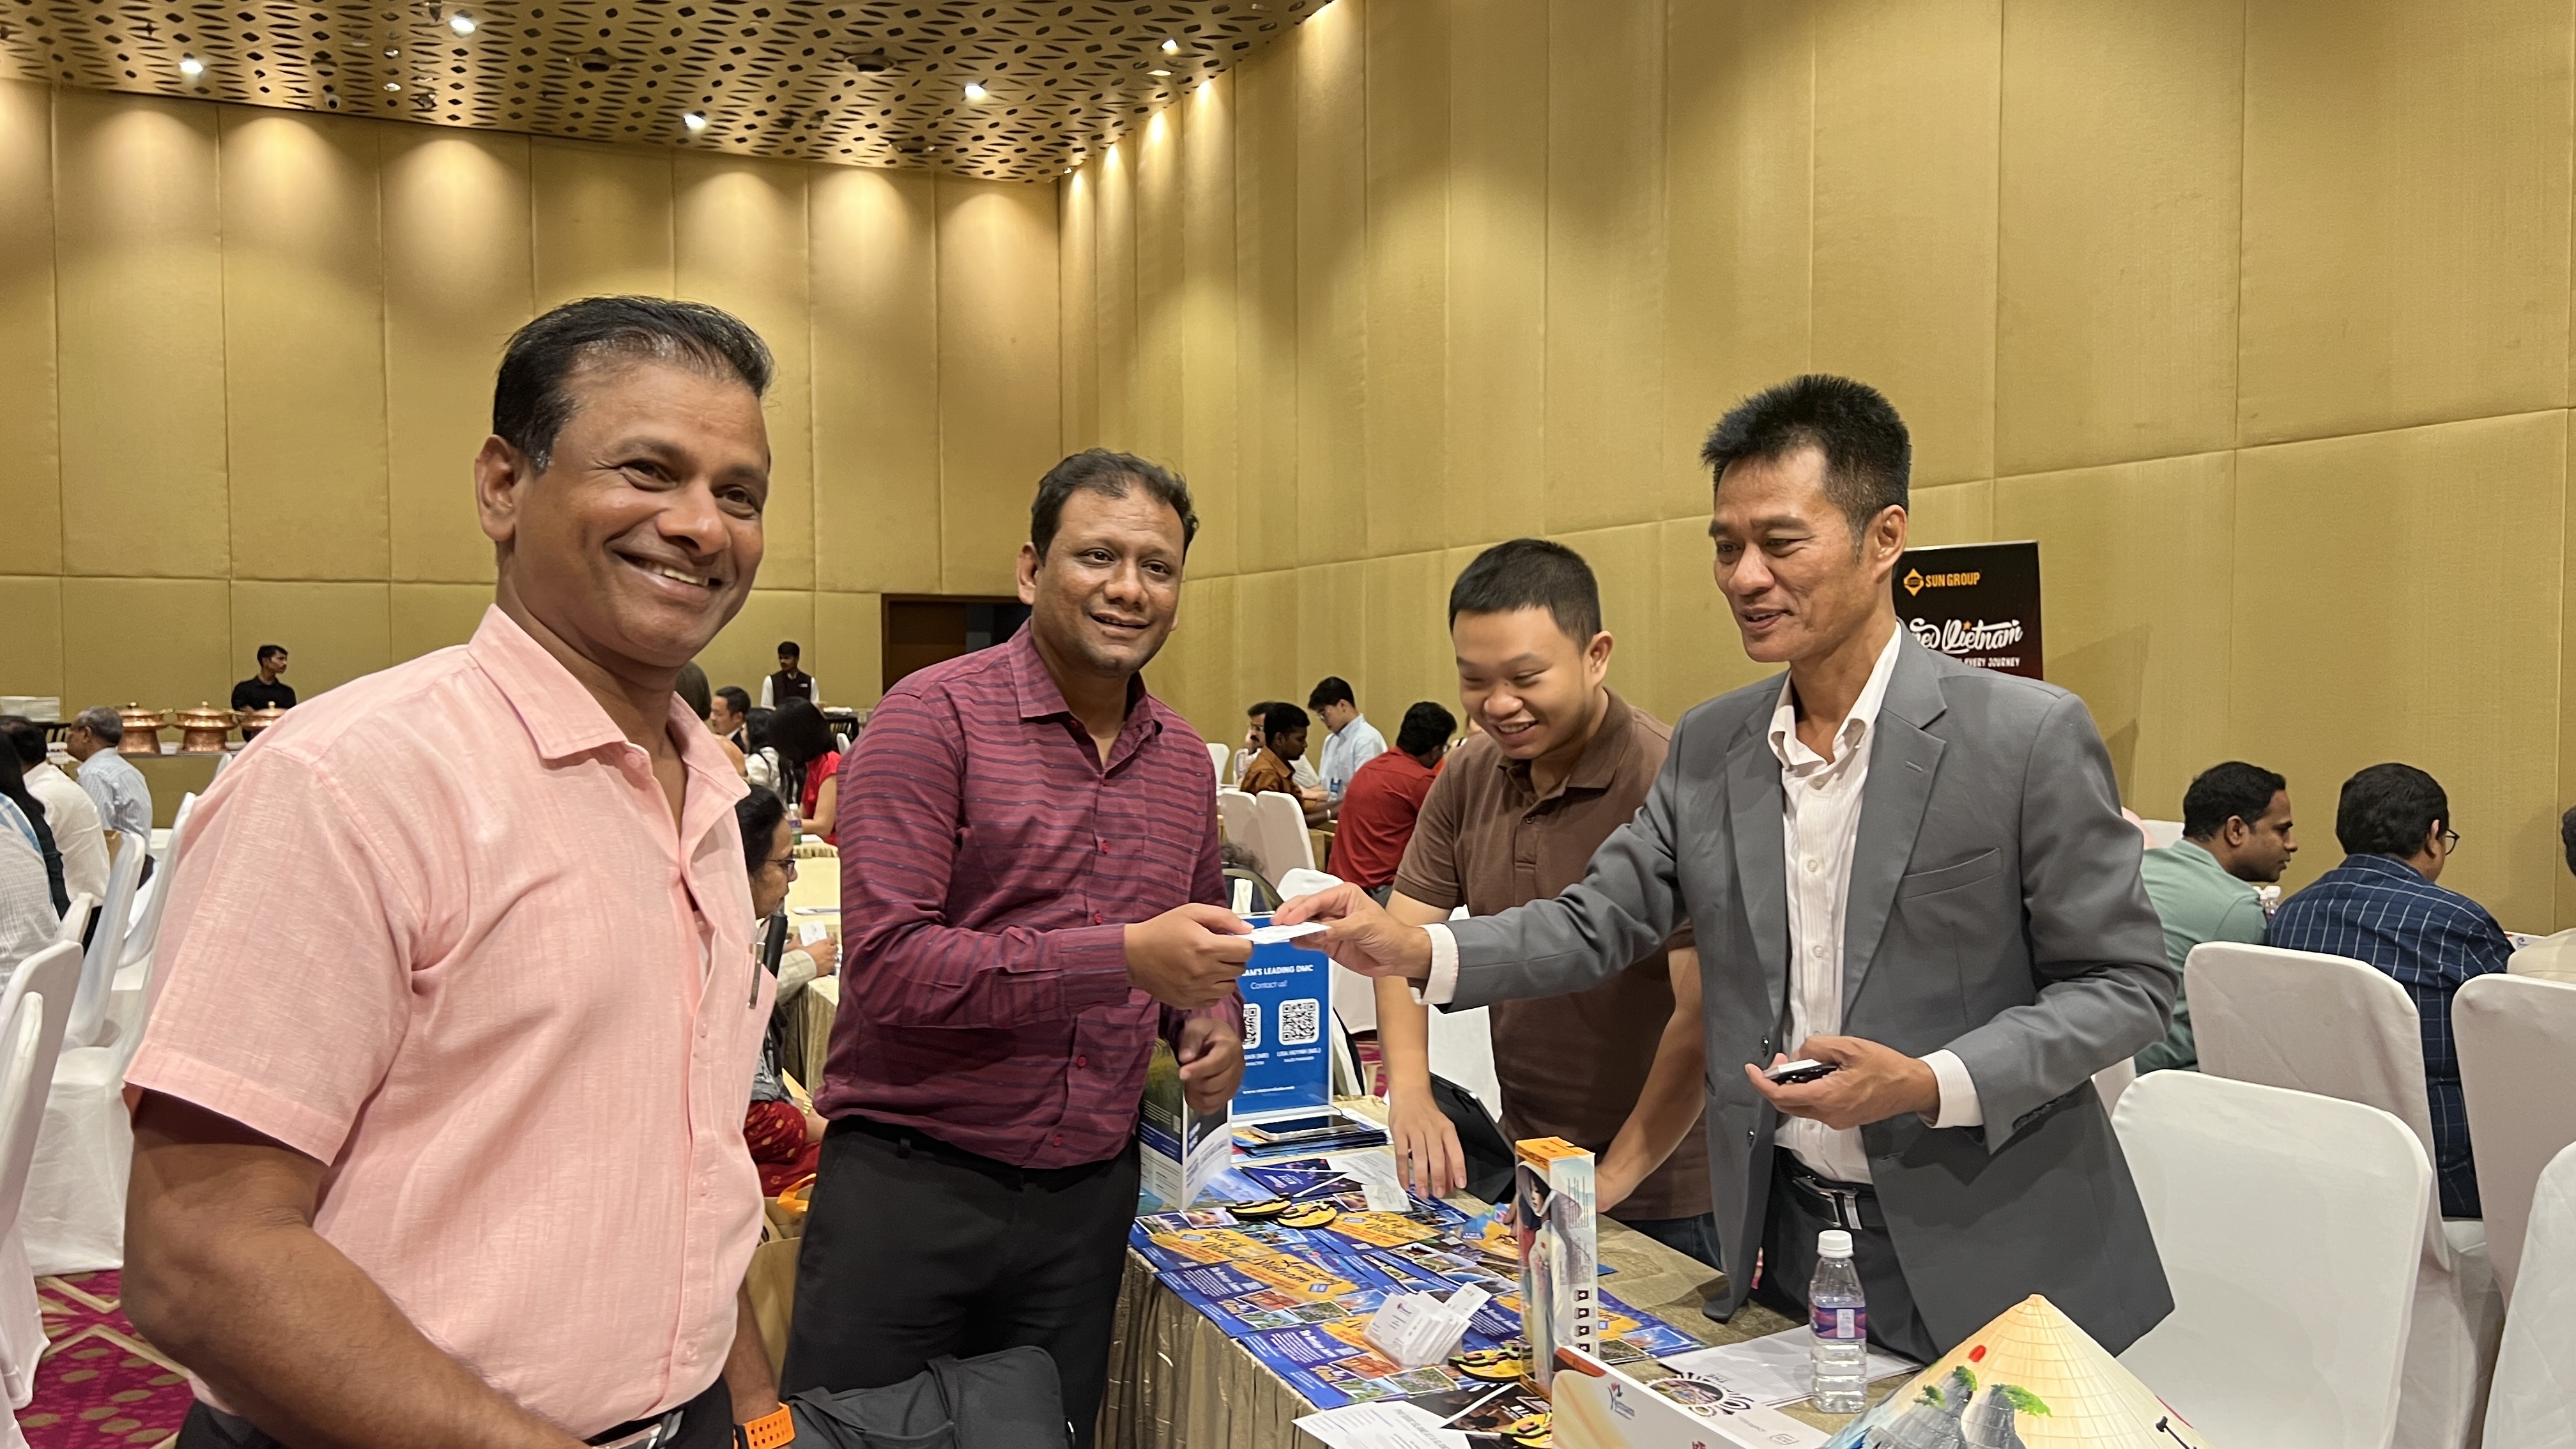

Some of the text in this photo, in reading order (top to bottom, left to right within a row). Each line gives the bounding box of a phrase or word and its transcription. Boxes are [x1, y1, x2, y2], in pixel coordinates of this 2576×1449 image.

[1926, 572, 1980, 587] SUN GROUP
[1942, 619, 2023, 654] Vietnam
[1988, 657, 2020, 667] JOURNEY
[1264, 965, 1295, 975] LEADING
[1296, 964, 1314, 972] DMC
[1250, 981, 1277, 990] Contact
[1252, 1258, 1310, 1283] Vietnam
[1282, 1259, 1343, 1285] Amazing
